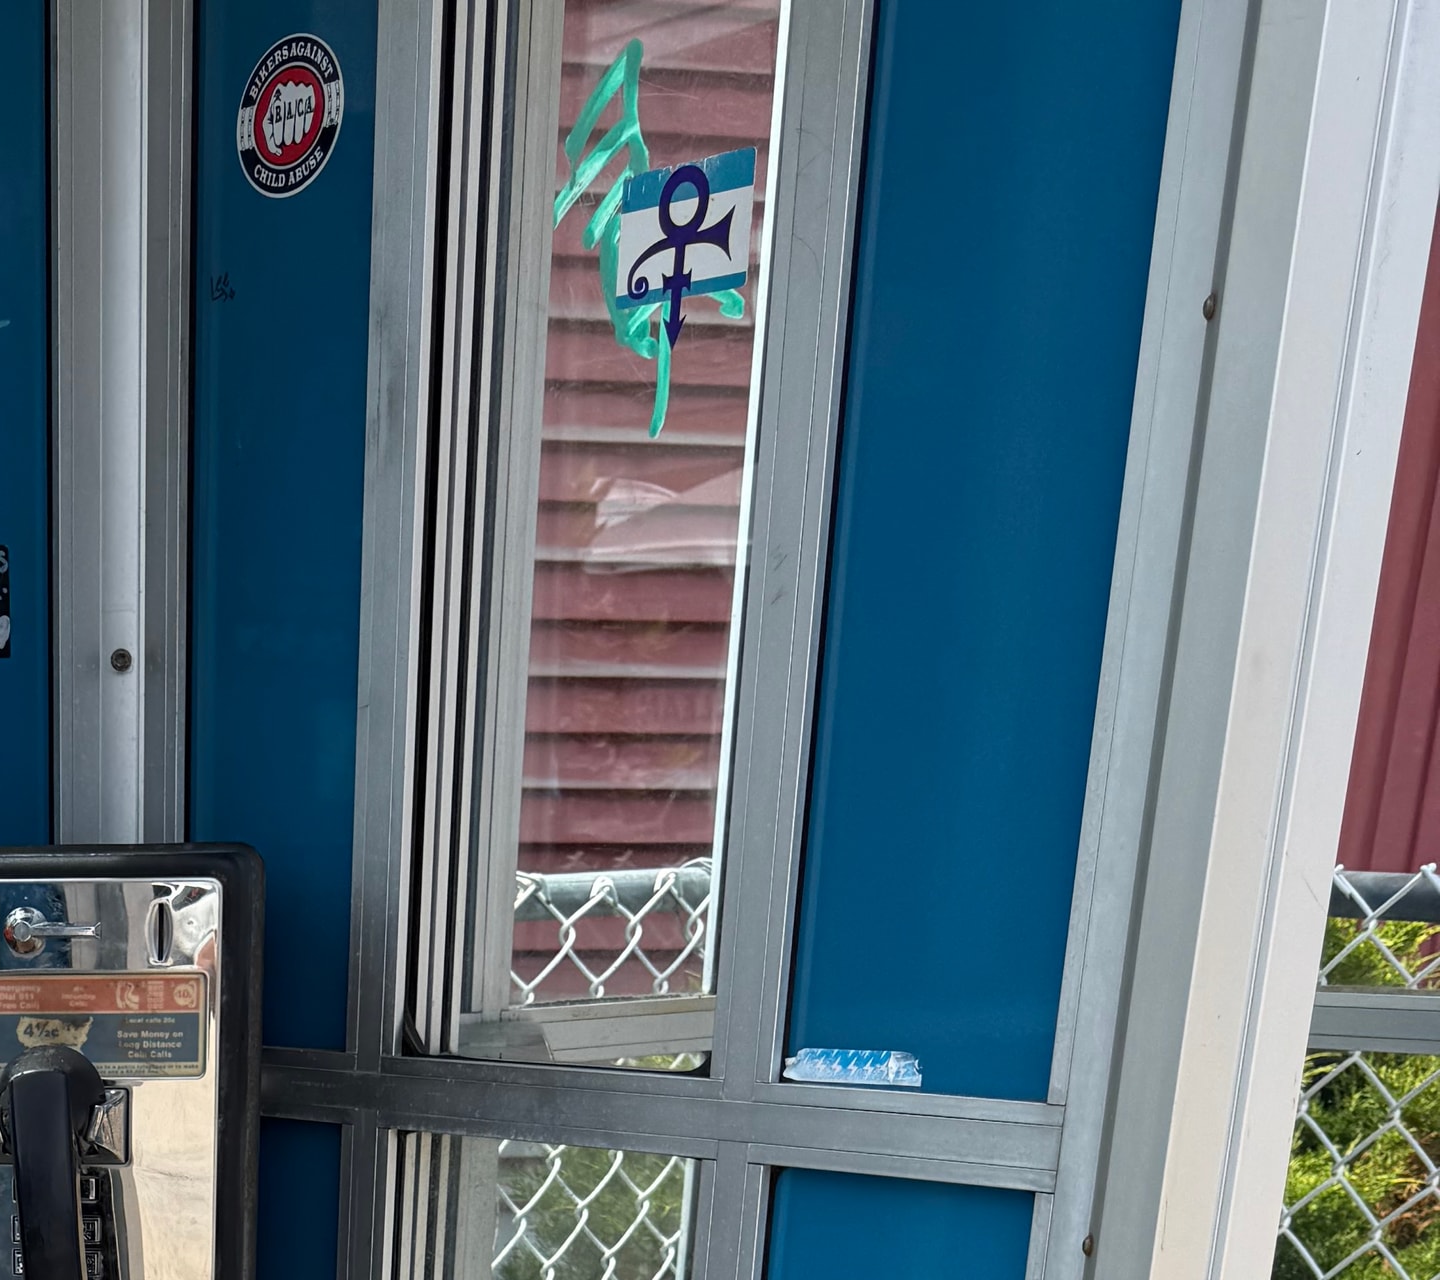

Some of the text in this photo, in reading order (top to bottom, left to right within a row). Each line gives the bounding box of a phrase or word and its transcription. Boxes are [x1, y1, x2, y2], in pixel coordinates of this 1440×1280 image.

[249, 42, 334, 101] BIKERS AGAINST
[254, 146, 324, 188] CHILD ABUSE
[0, 993, 16, 1001] Dial
[117, 1031, 139, 1039] Save
[141, 1031, 170, 1040] Money
[142, 1040, 182, 1048] Distance
[150, 1050, 172, 1058] Calls
